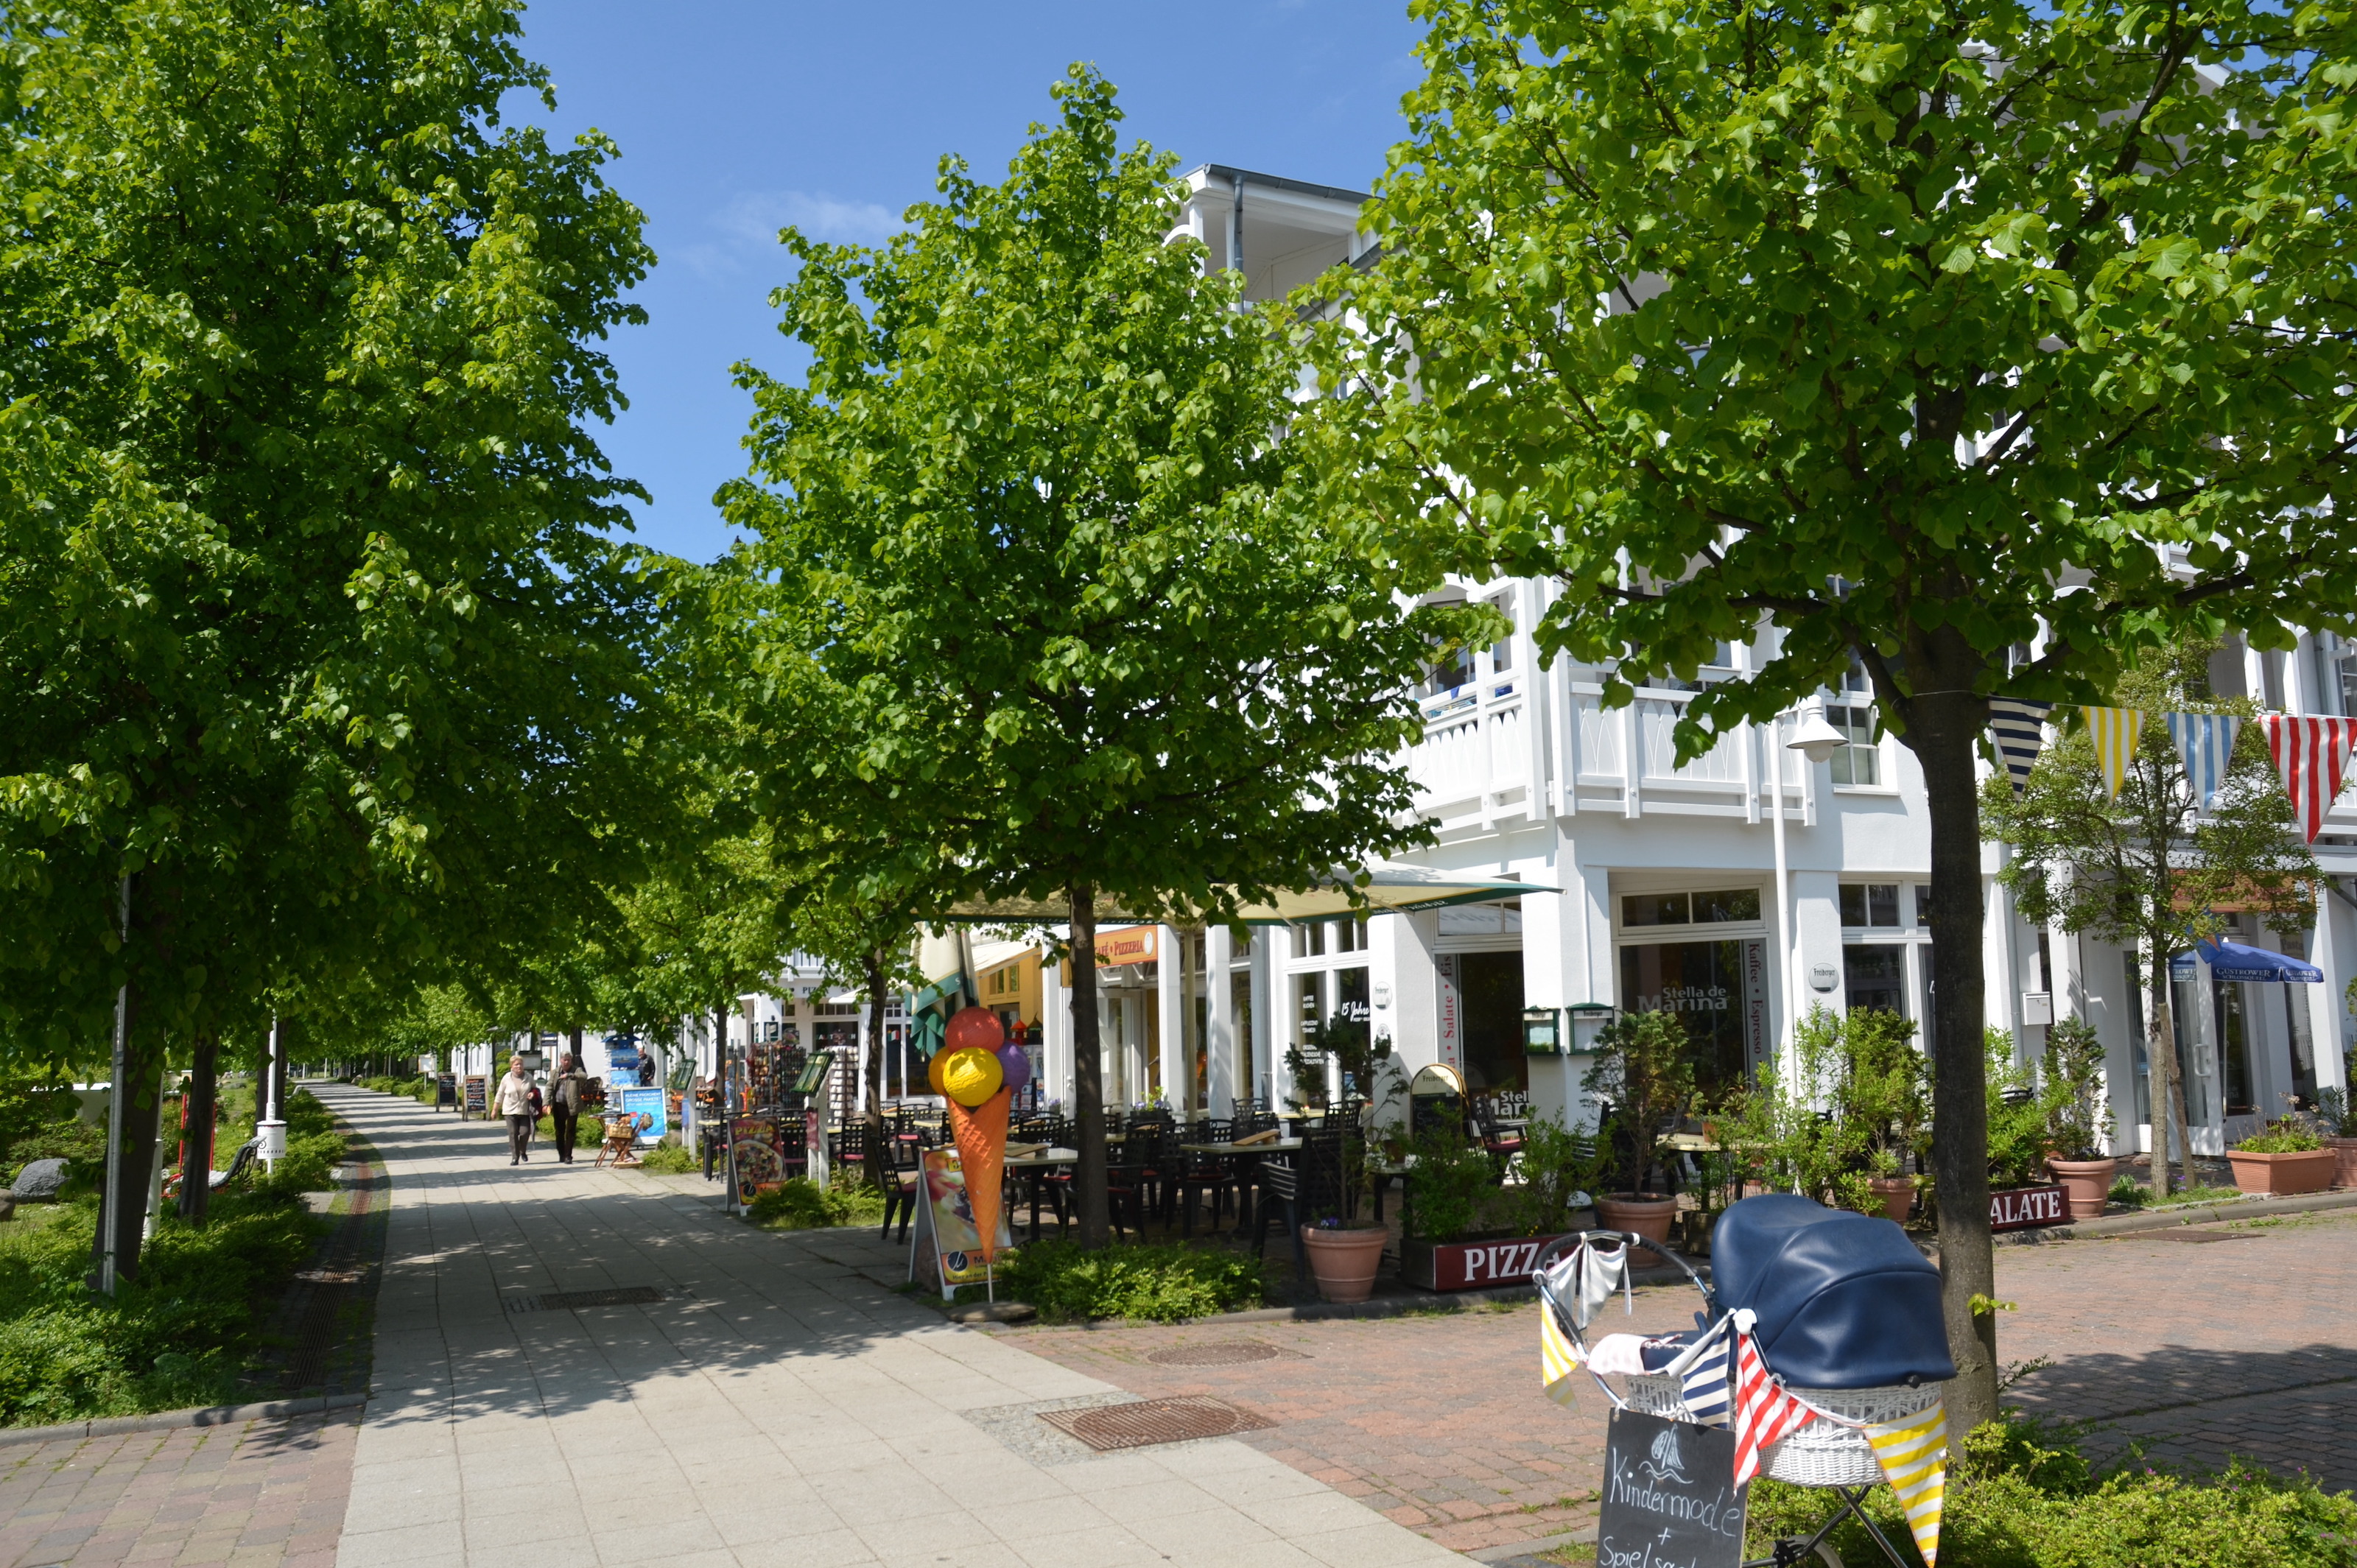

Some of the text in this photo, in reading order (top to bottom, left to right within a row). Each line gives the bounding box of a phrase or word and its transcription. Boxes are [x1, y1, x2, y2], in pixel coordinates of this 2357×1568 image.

[1114, 940, 1144, 956] PIZZERIA
[1813, 968, 1836, 978] Freiberger
[1441, 956, 1454, 1038] Salate Eis
[1662, 985, 1727, 999] Stella de
[1749, 943, 1763, 1054] Kaffee Espresso
[1341, 1001, 1370, 1022] 15 Jahre
[1637, 995, 1727, 1012] Marina
[1500, 1091, 1530, 1102] Stell
[1990, 1191, 2061, 1225] ALATE
[1609, 1447, 1740, 1537] Kindermode
